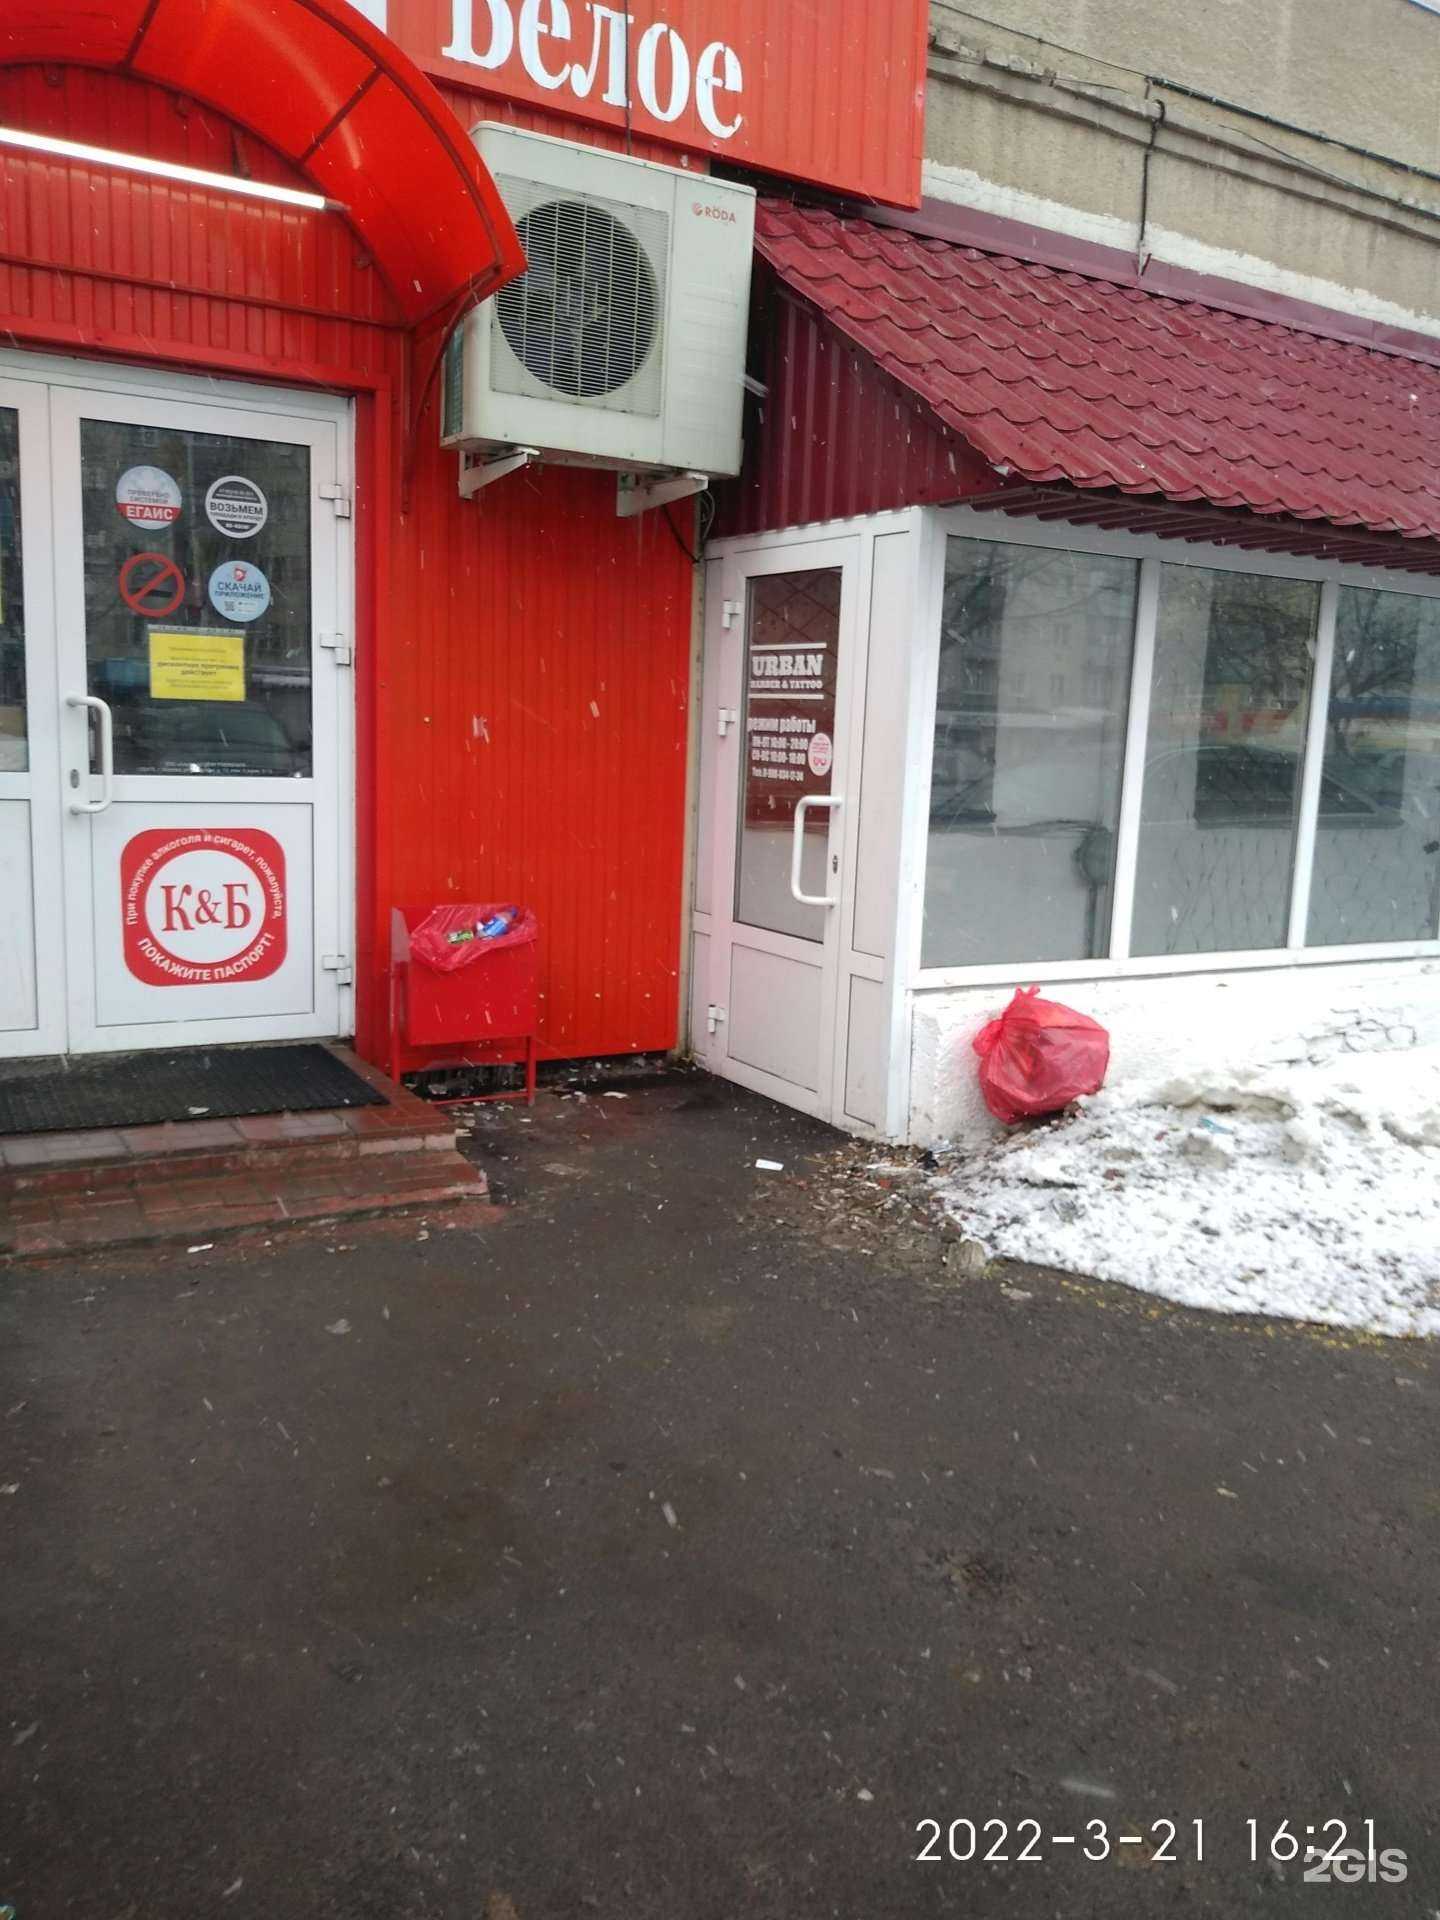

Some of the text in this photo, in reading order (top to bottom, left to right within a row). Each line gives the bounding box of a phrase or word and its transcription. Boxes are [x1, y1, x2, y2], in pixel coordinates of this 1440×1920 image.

[127, 505, 173, 520] ЕГАИС
[210, 502, 264, 516] ВОЗЬМЕМ
[218, 582, 262, 592] СКАЧАЙ
[752, 654, 823, 676] URBAN
[781, 680, 789, 689] &
[789, 680, 823, 689] TATTOO
[780, 715, 816, 733] работы
[152, 834, 201, 857] алкоголя
[204, 833, 212, 842] и
[213, 835, 256, 860] сигарет,
[129, 858, 153, 901] покупке
[127, 902, 138, 925] При
[160, 884, 251, 931] К&Б
[137, 932, 276, 980] ПОКАЖИТЕ ПАСПОРТ!
